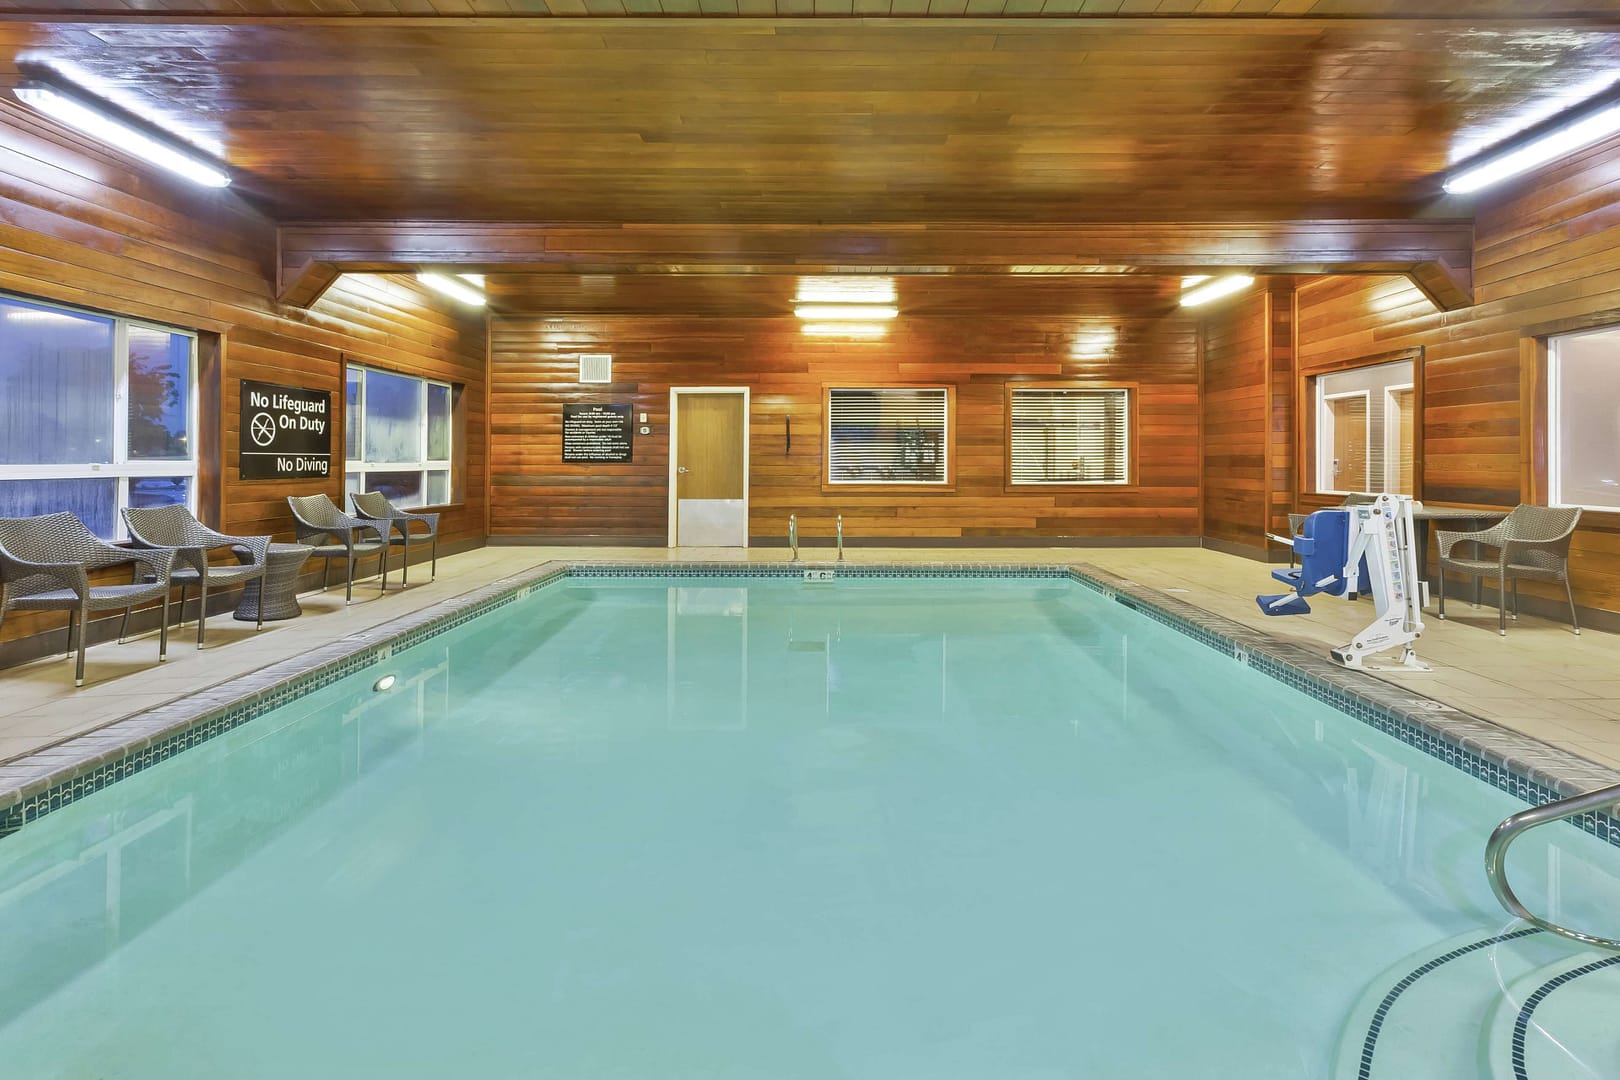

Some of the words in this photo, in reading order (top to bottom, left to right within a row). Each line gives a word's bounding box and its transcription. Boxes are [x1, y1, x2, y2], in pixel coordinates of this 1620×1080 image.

[250, 391, 269, 408] No
[272, 394, 326, 415] Lifeguard
[279, 414, 297, 430] On
[299, 416, 326, 435] Duty
[277, 457, 294, 472] No
[296, 457, 328, 475] Diving
